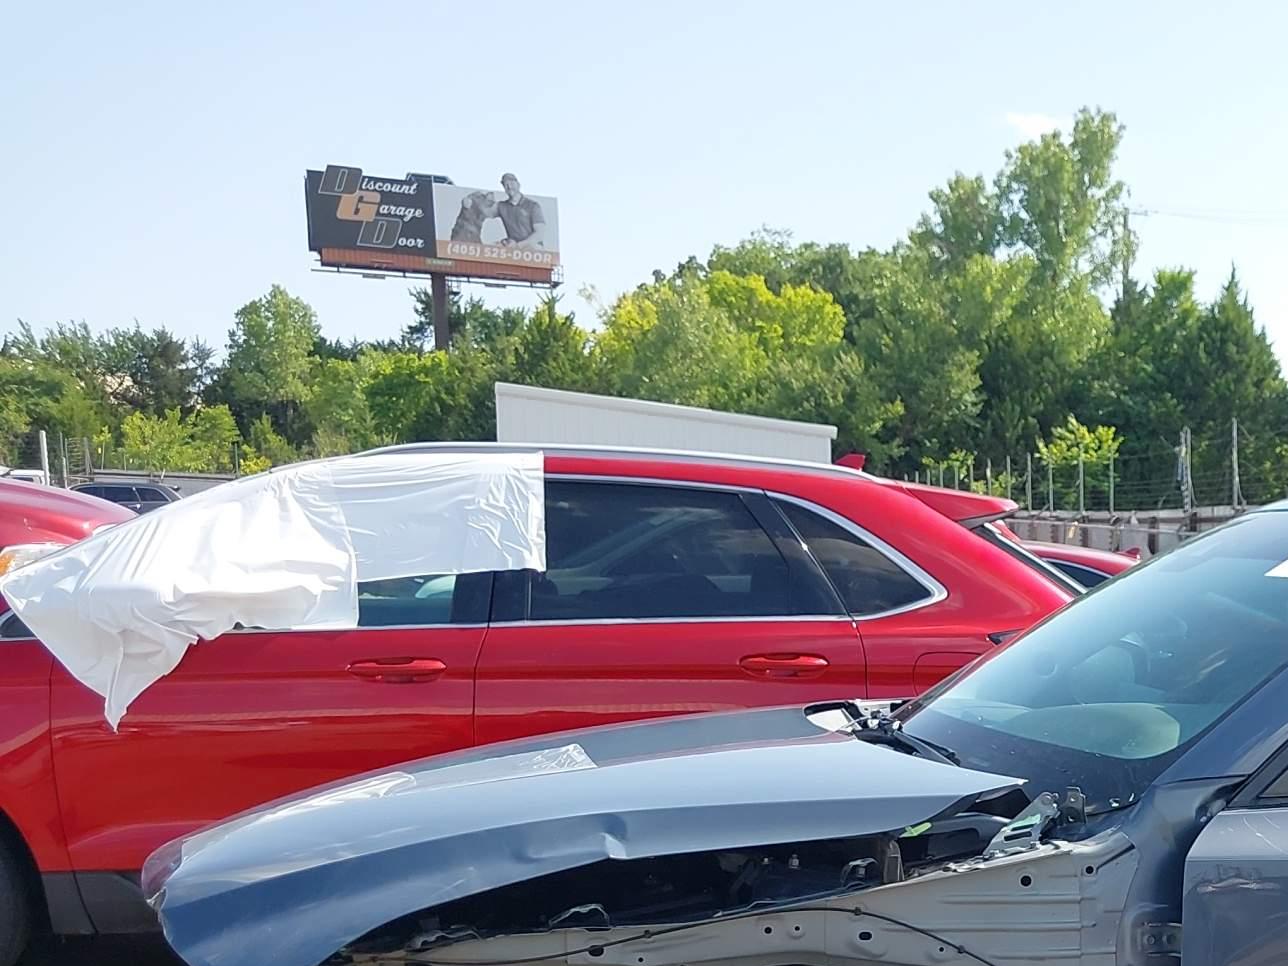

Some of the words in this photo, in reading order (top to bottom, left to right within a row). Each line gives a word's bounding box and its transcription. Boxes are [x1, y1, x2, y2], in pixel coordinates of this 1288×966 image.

[318, 164, 418, 196] Discount
[336, 190, 425, 223] Garage
[356, 216, 425, 249] Door
[446, 242, 481, 257] (405)
[484, 245, 553, 265] 525-DOOR
